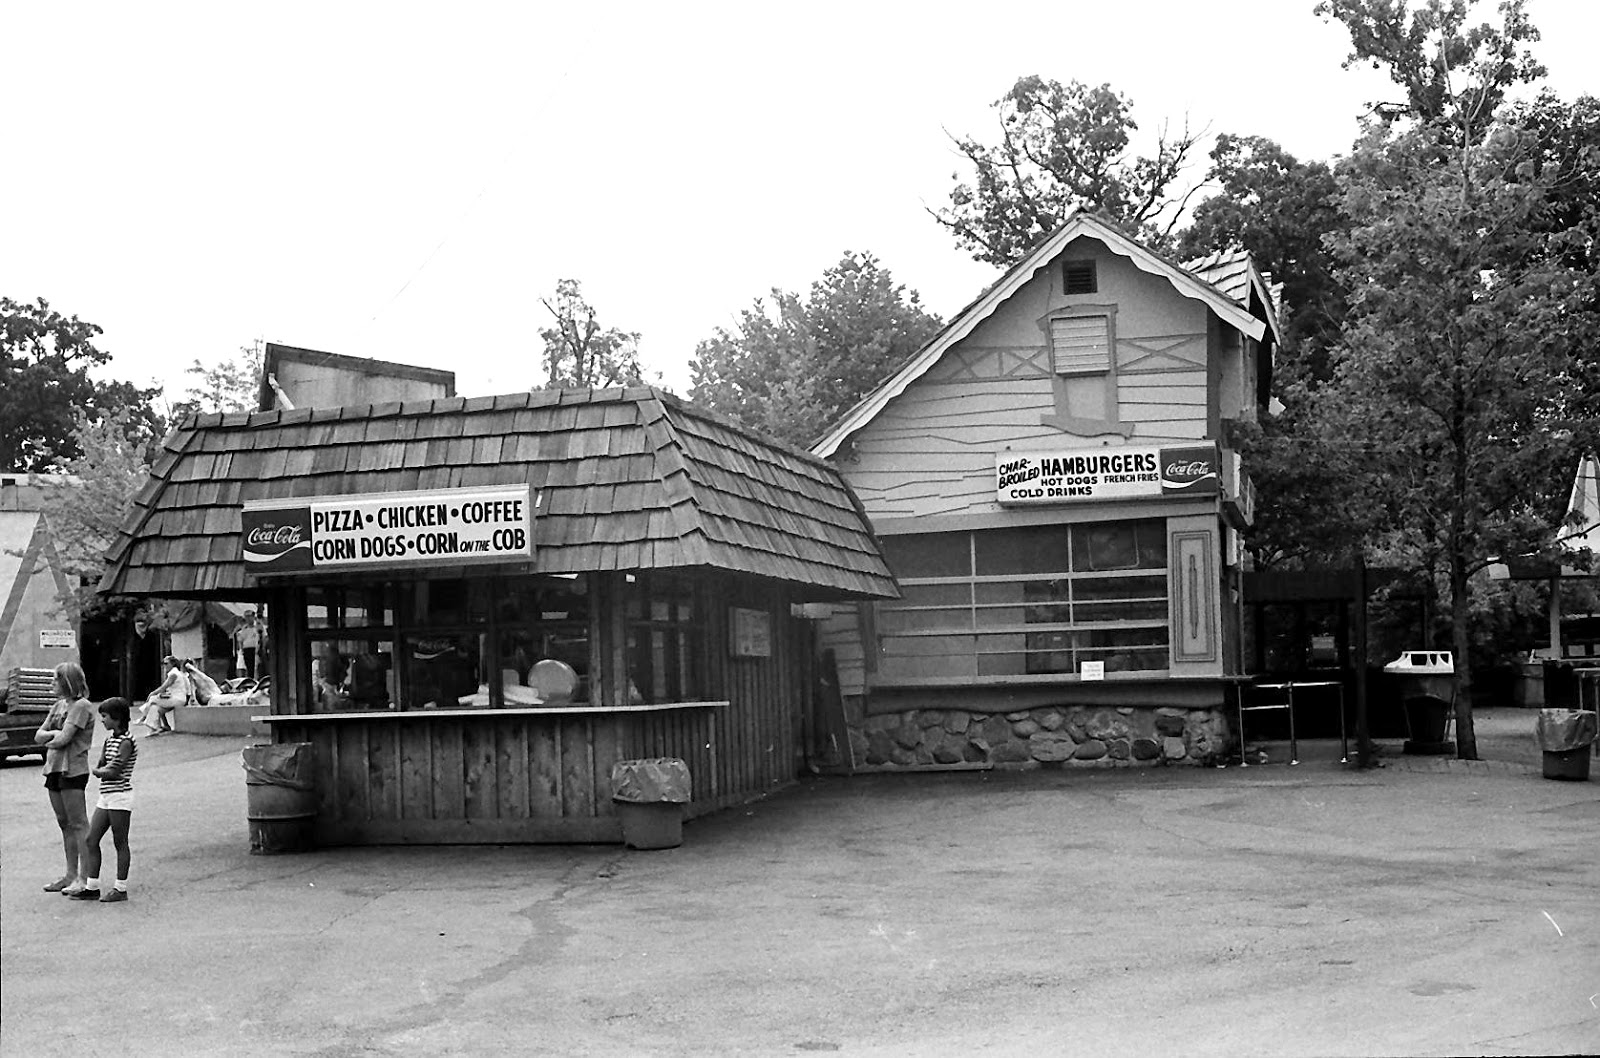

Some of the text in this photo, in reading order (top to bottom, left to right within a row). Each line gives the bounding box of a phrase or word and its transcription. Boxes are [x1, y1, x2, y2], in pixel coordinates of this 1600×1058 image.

[999, 458, 1031, 475] CHAR-
[1041, 453, 1157, 476] HAMBURGERS
[999, 467, 1040, 489] BROILED
[1041, 476, 1098, 486] HOT DOGS
[1104, 472, 1159, 483] FRENCH FRIES
[1010, 486, 1093, 499] COLD DRINKS
[313, 500, 523, 533] PIZZA CHICKEN COFFEE
[247, 524, 303, 546] Coca-Cola
[314, 528, 526, 561] CORN DOGS CORN ON THE COB
